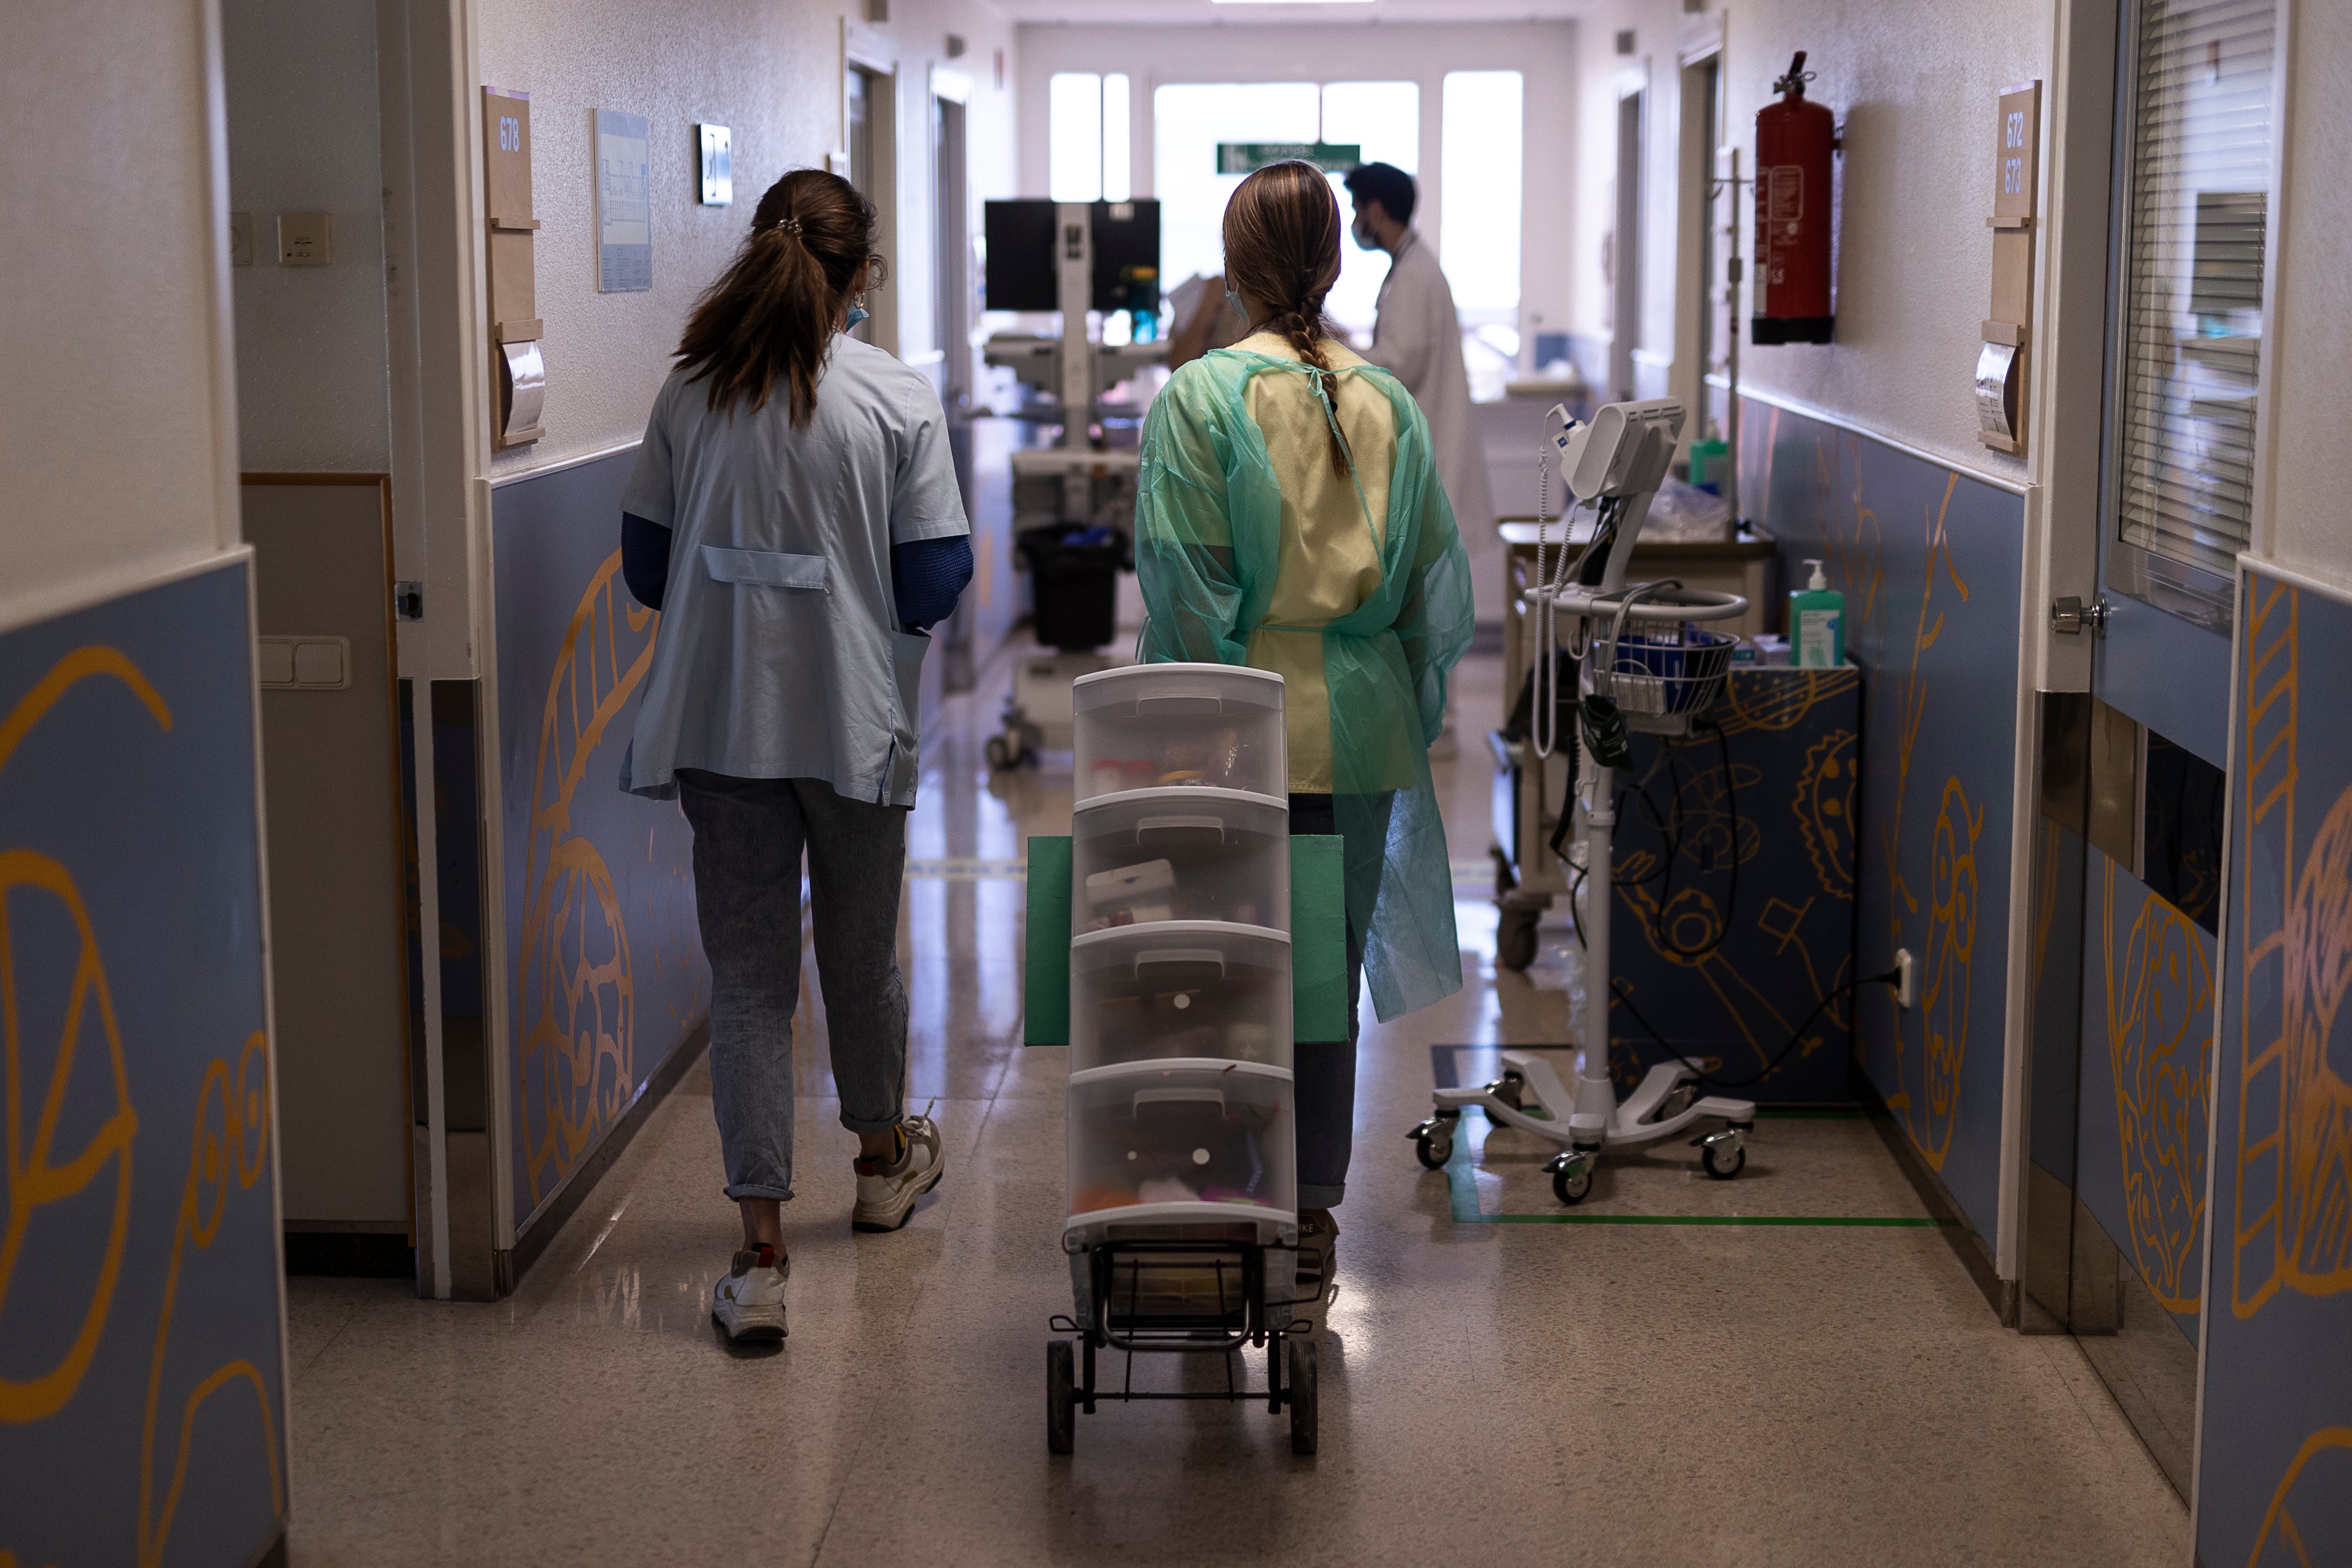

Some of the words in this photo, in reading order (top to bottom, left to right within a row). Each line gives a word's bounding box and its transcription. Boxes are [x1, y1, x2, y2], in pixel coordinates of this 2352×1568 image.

[500, 116, 519, 152] 678
[2007, 112, 2023, 149] 672
[2005, 159, 2021, 194] 673
[1299, 1223, 1314, 1233] IKE
